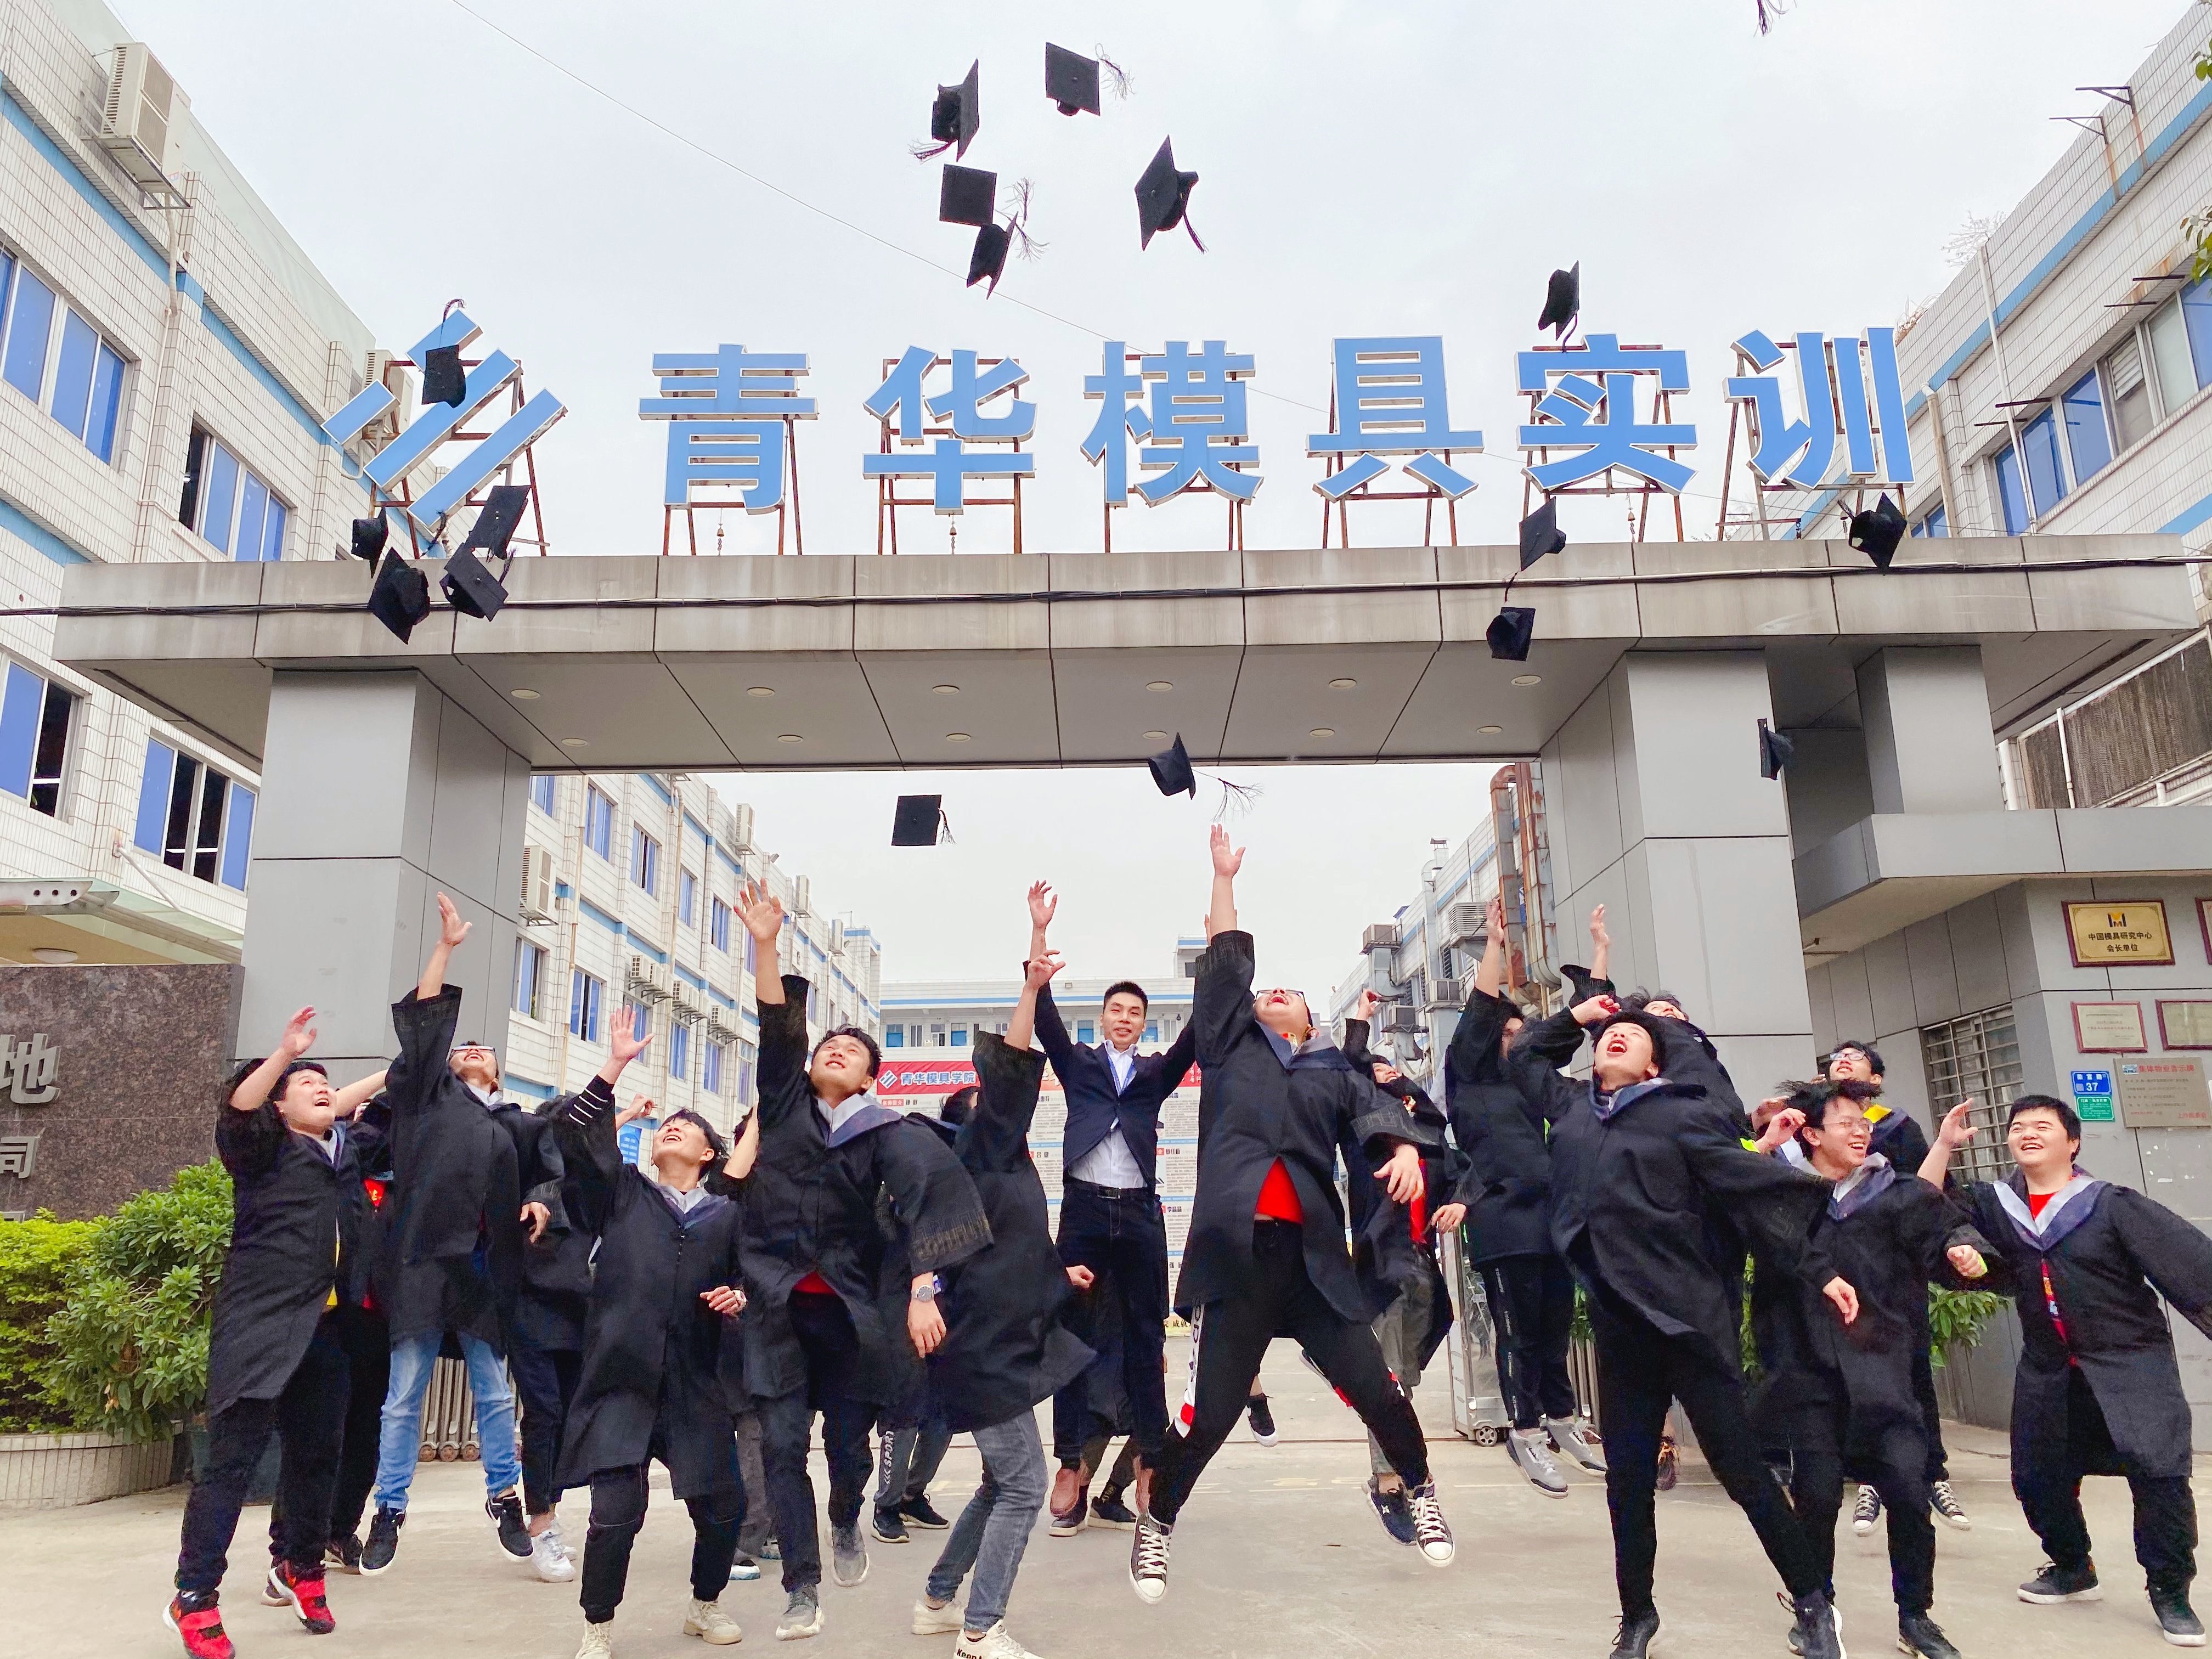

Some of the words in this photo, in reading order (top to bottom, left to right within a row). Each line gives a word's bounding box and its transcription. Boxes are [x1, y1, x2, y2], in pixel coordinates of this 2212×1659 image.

[639, 327, 1915, 515] 青华模具实训
[2089, 932, 2152, 941] 中国模具研究中心
[2107, 944, 2138, 952] 会长单位
[901, 1071, 976, 1086] 青华模具学院
[2086, 1082, 2098, 1091] 37
